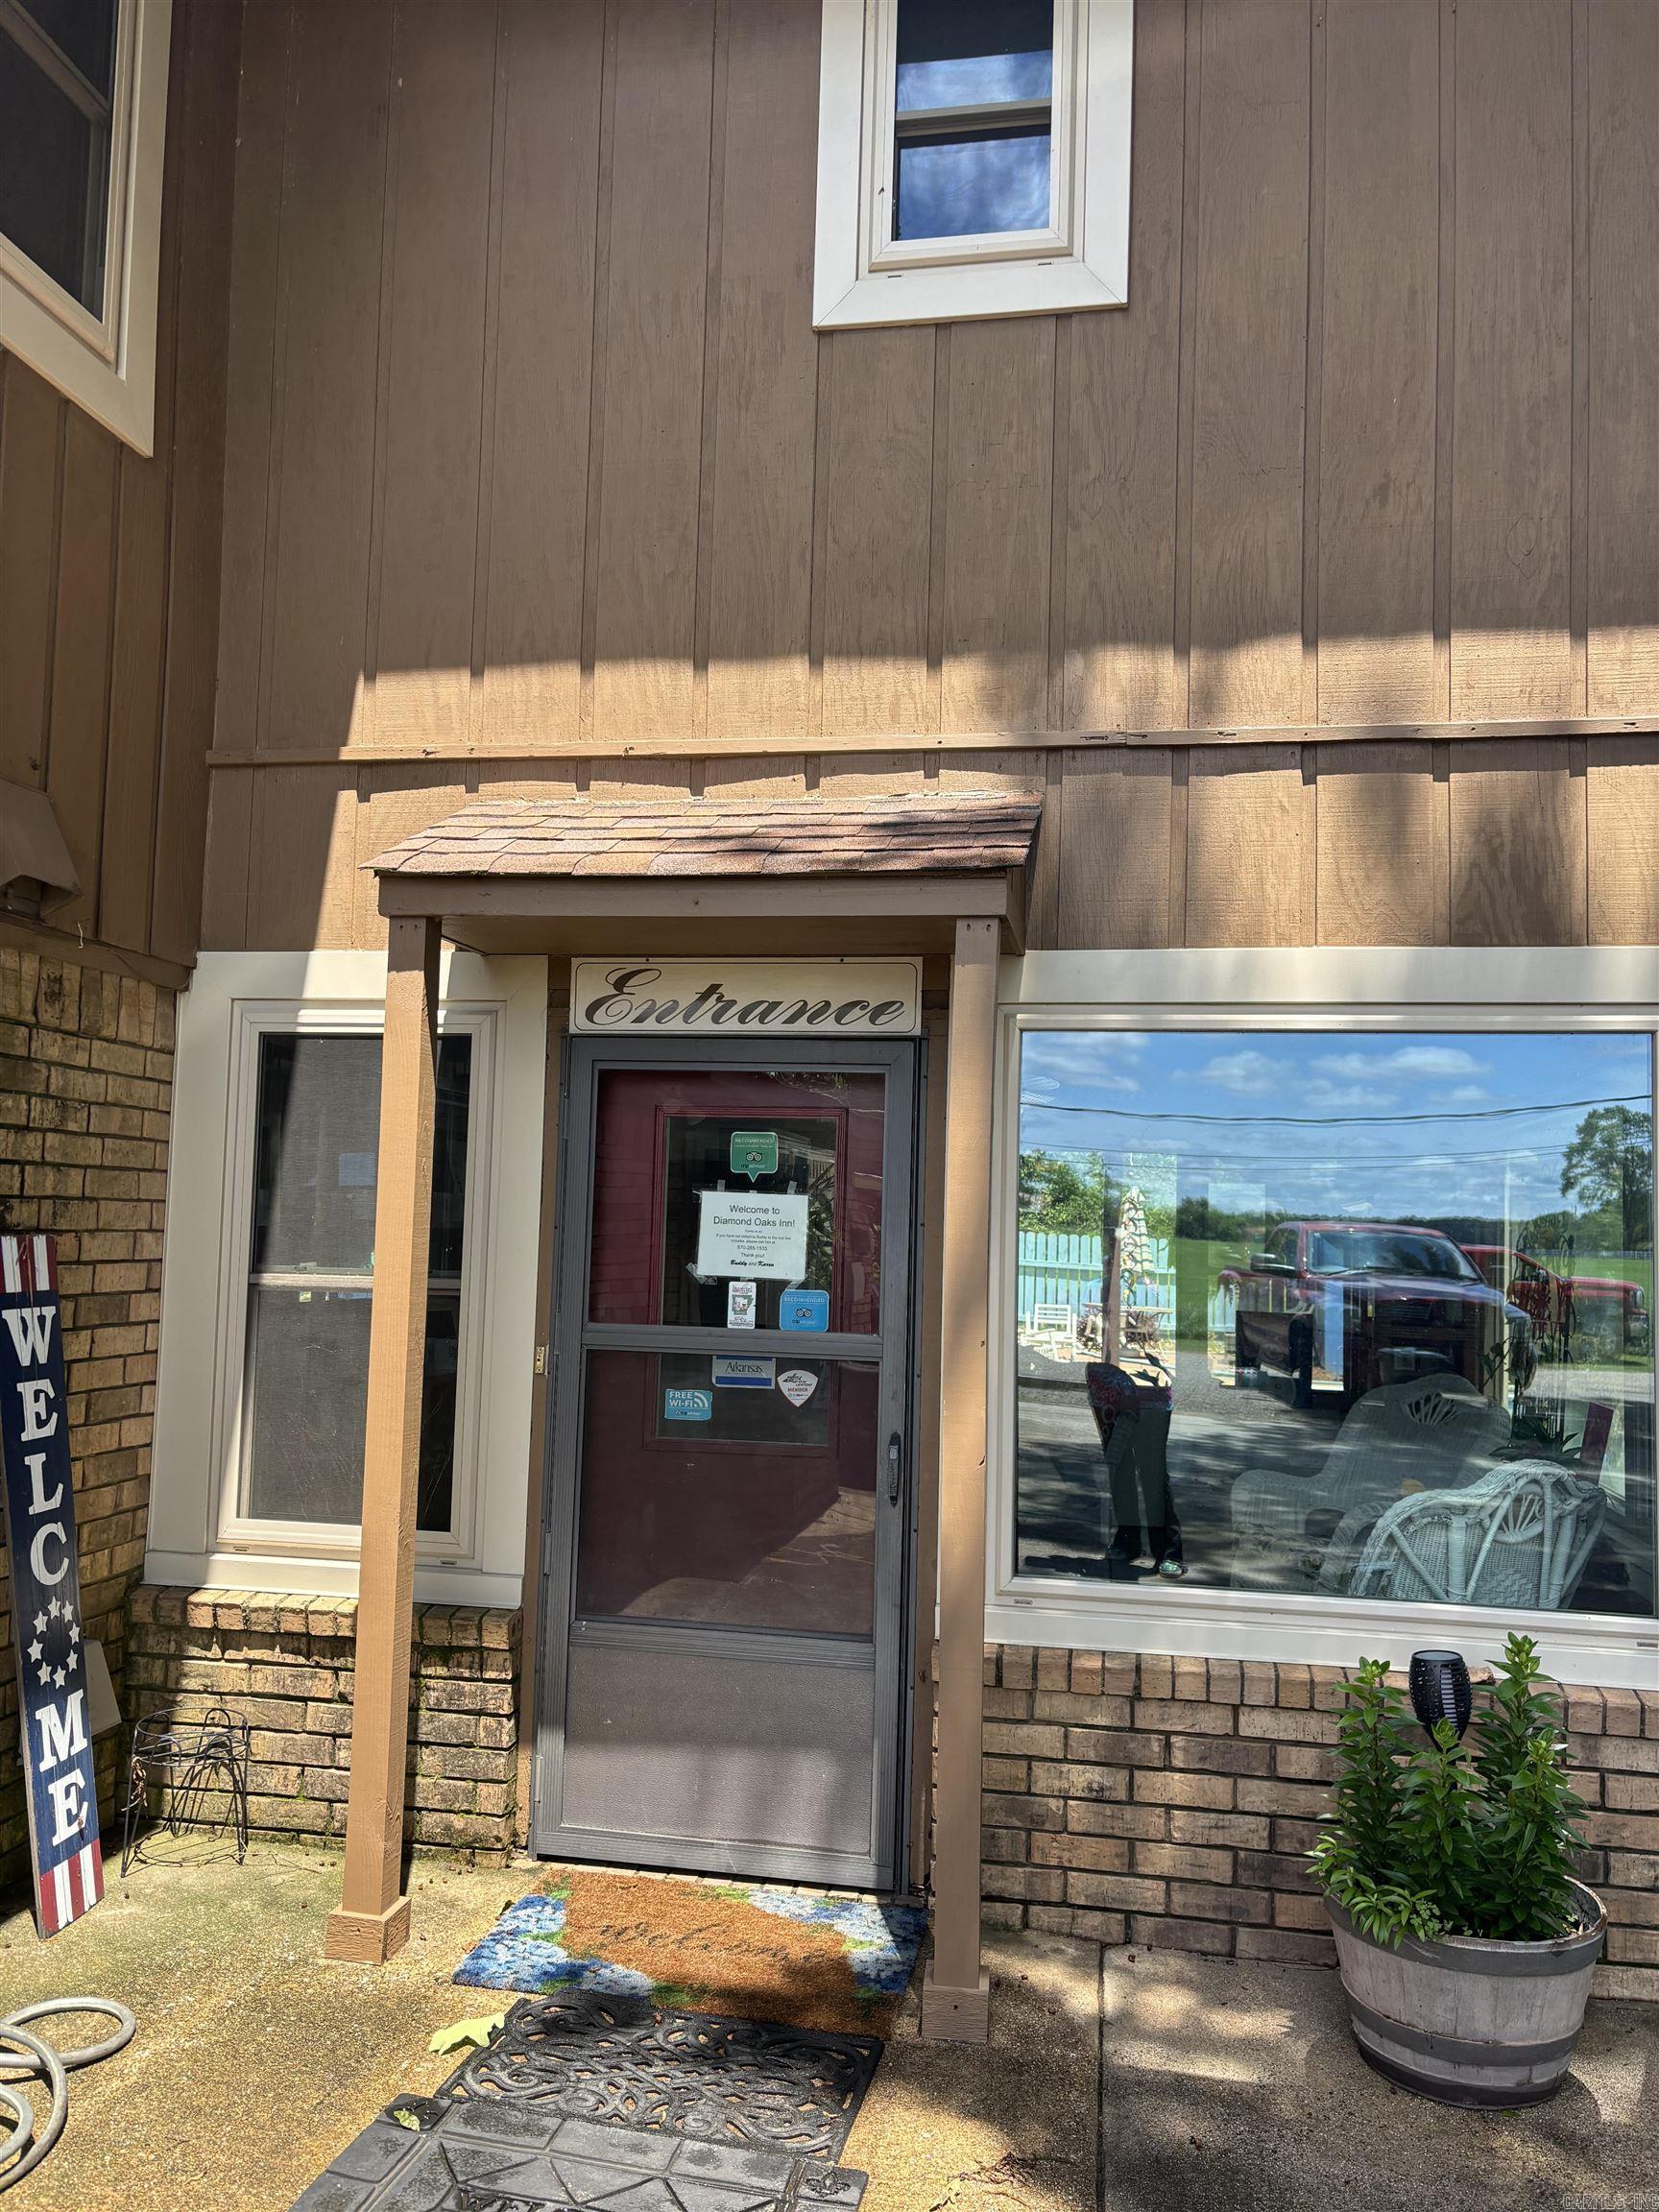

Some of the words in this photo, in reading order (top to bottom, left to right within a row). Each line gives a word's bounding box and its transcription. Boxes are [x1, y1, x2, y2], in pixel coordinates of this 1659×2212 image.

[585, 967, 907, 1026] Entrance
[730, 1205, 770, 1214] Welcome
[772, 1207, 781, 1215] to
[713, 1215, 752, 1226] Diamond
[754, 1217, 777, 1227] Oaks
[725, 1361, 765, 1374] Arkansas
[669, 1399, 693, 1407] WI-FI
